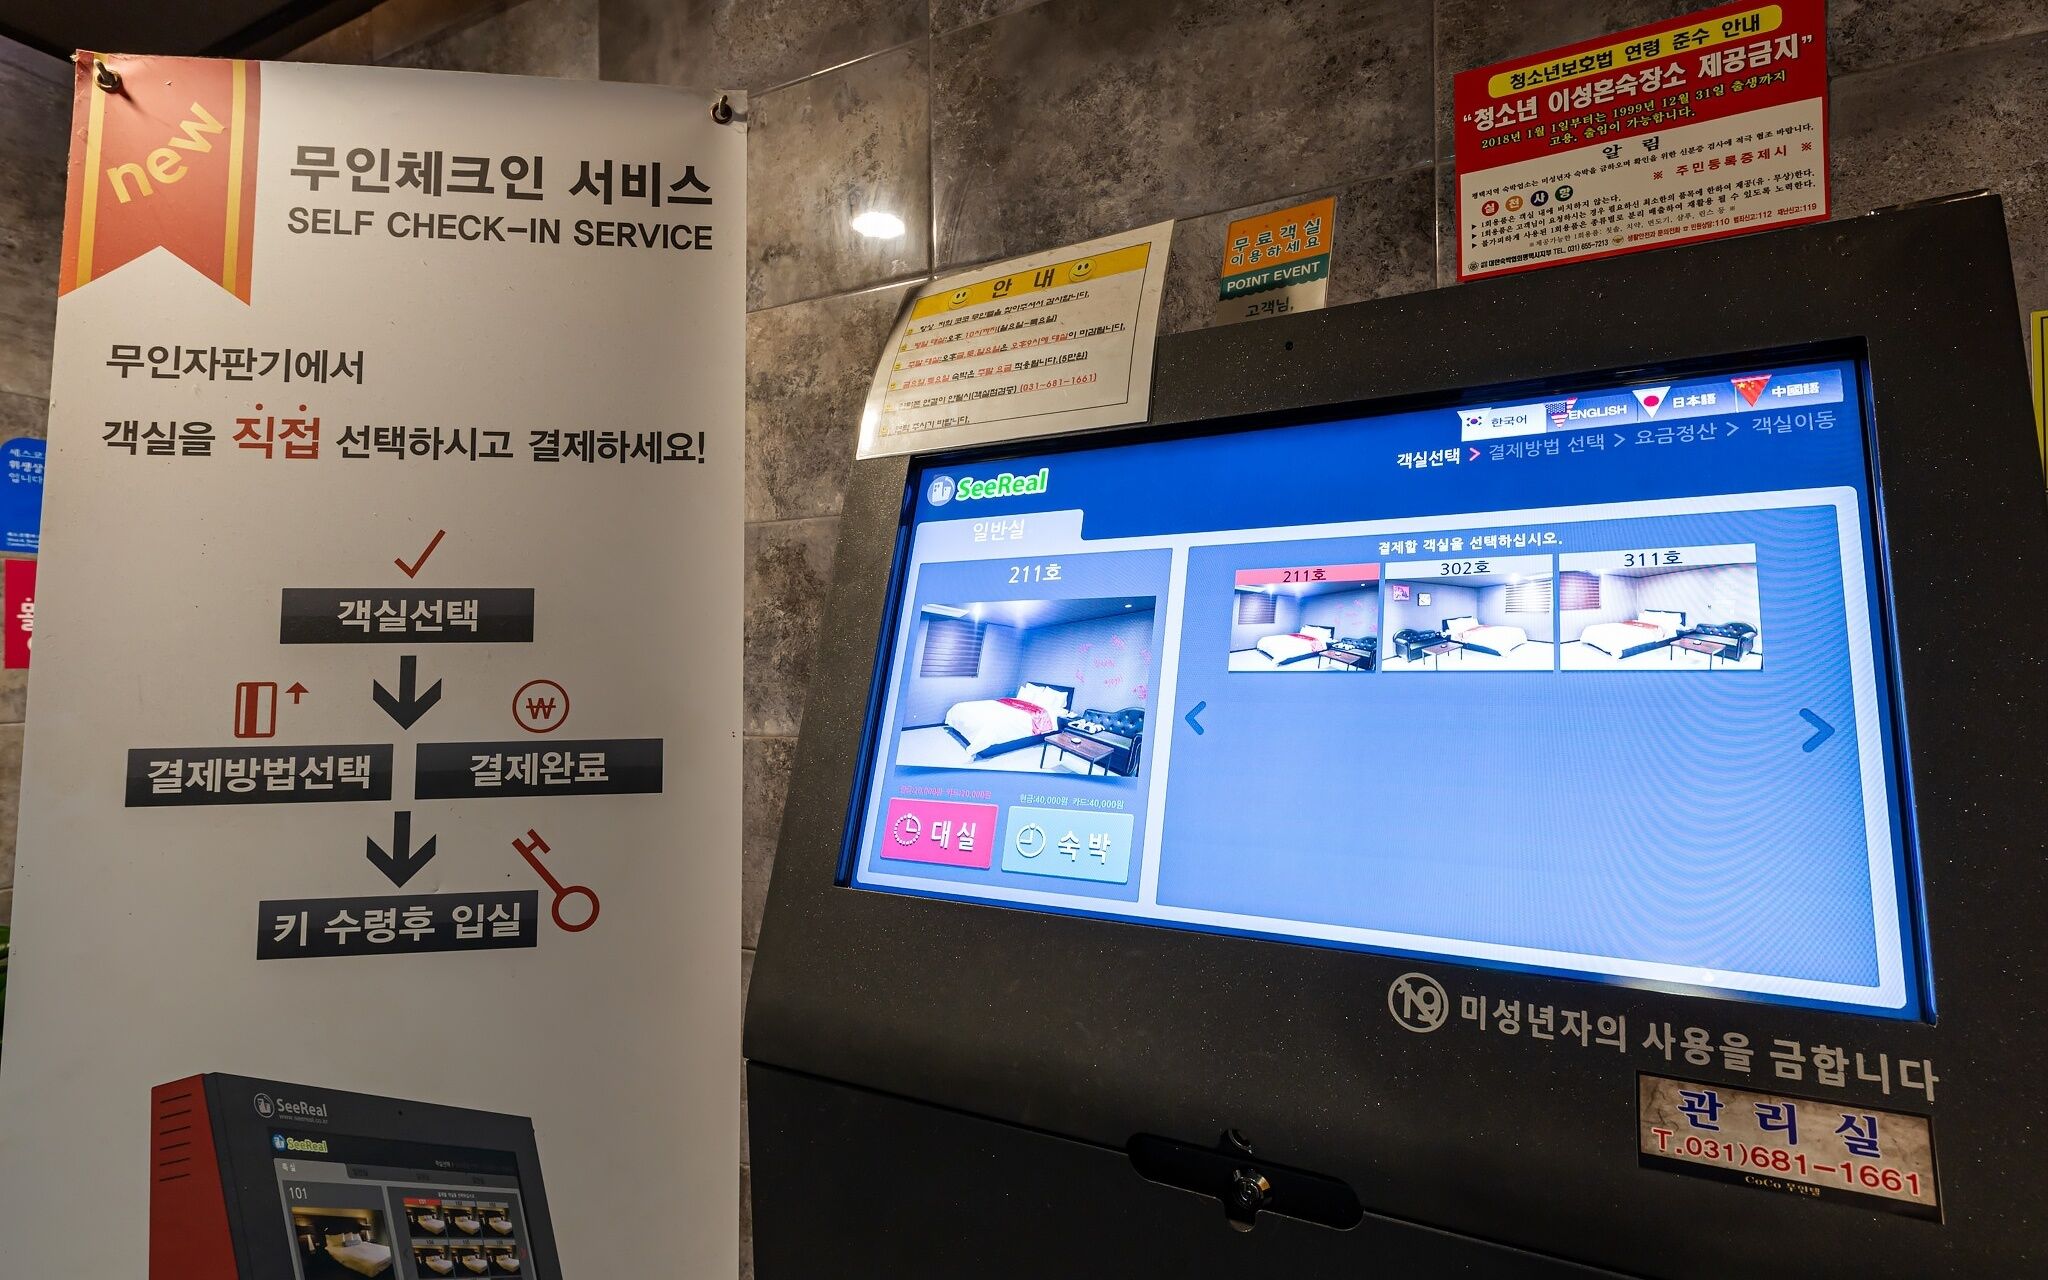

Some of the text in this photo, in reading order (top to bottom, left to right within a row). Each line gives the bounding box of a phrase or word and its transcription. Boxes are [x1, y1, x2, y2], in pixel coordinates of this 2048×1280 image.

[1511, 14, 1760, 90] 청소년보호법 연령 준수 안내
[1548, 62, 1687, 113] 이성혼숙장소
[1481, 70, 1786, 149] 2018년 1월 1일부터는 1999년 12월 31일 출생까지
[1584, 121, 1620, 139] 출입이
[1626, 106, 1695, 128] 가능합니다.
[107, 102, 226, 203] new
[290, 145, 713, 208] 무인체크인 서비스
[287, 207, 713, 251] SELF CHECK-IN SERVICE
[1227, 262, 1320, 292] POINT EVENT
[105, 343, 365, 385] 무인자판기에서
[1490, 382, 1820, 429] 한국어 ENGLISH 日本語 中國語
[103, 415, 706, 464] 객실을 직접 선택하시고 결제하세요!
[1397, 410, 1836, 470] 객실선택 결제방법 선택 요금정산 객실이동
[955, 468, 1049, 501] SeeReal
[973, 519, 1025, 543] 일반실
[1378, 532, 1564, 556] 결제할 객실을 선택하십시오.
[1008, 563, 1062, 585] 211호
[1283, 567, 1326, 584] 211호
[1440, 560, 1490, 577] 302호
[1623, 549, 1683, 569] 311호
[338, 599, 479, 633] 객실선택
[148, 754, 371, 795] 결제방법선택
[470, 751, 609, 787] 결제완료
[274, 903, 521, 946] 키 수령후 입실
[1462, 994, 1941, 1101] 미성년자의 사용을 금합니다
[276, 1098, 328, 1117] SeeReal
[286, 1137, 329, 1153] SeeReal
[289, 1187, 307, 1199] 101
